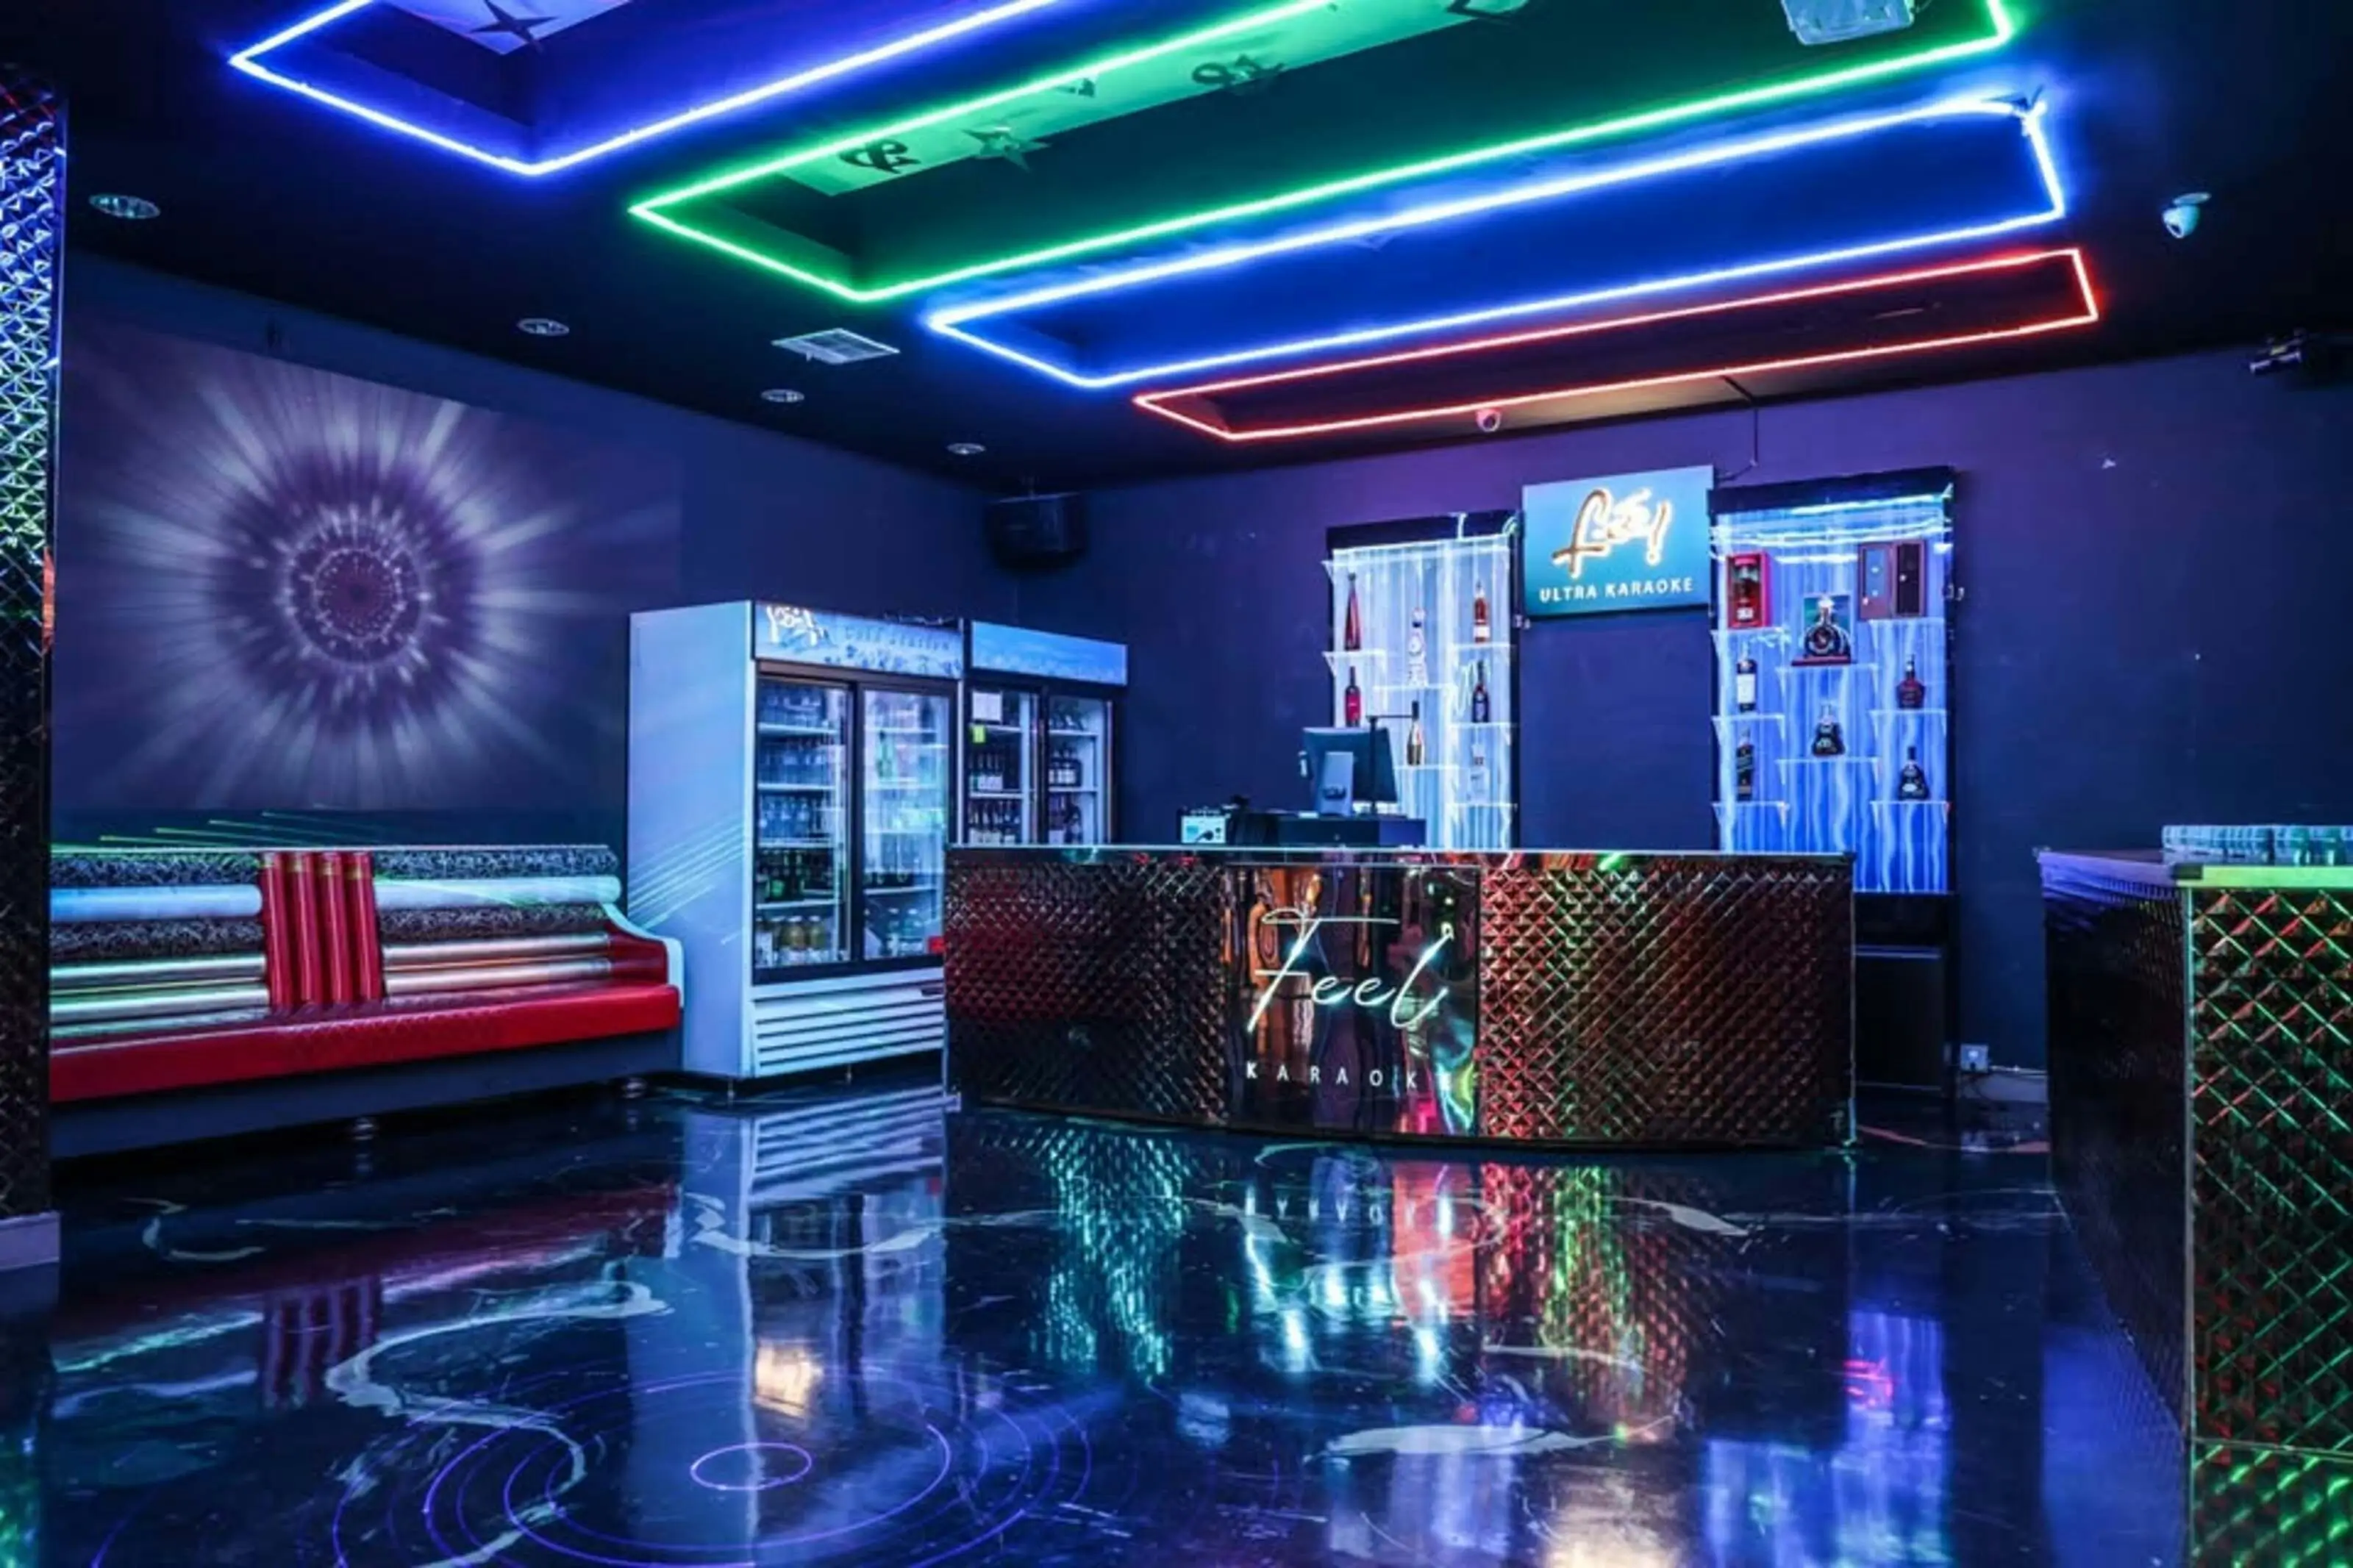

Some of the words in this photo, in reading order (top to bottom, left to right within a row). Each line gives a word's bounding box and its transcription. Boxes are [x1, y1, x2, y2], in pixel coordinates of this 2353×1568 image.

[1539, 584, 1597, 604] ULTRA
[1604, 576, 1694, 599] KARAOKE
[1246, 907, 1454, 1034] Feel
